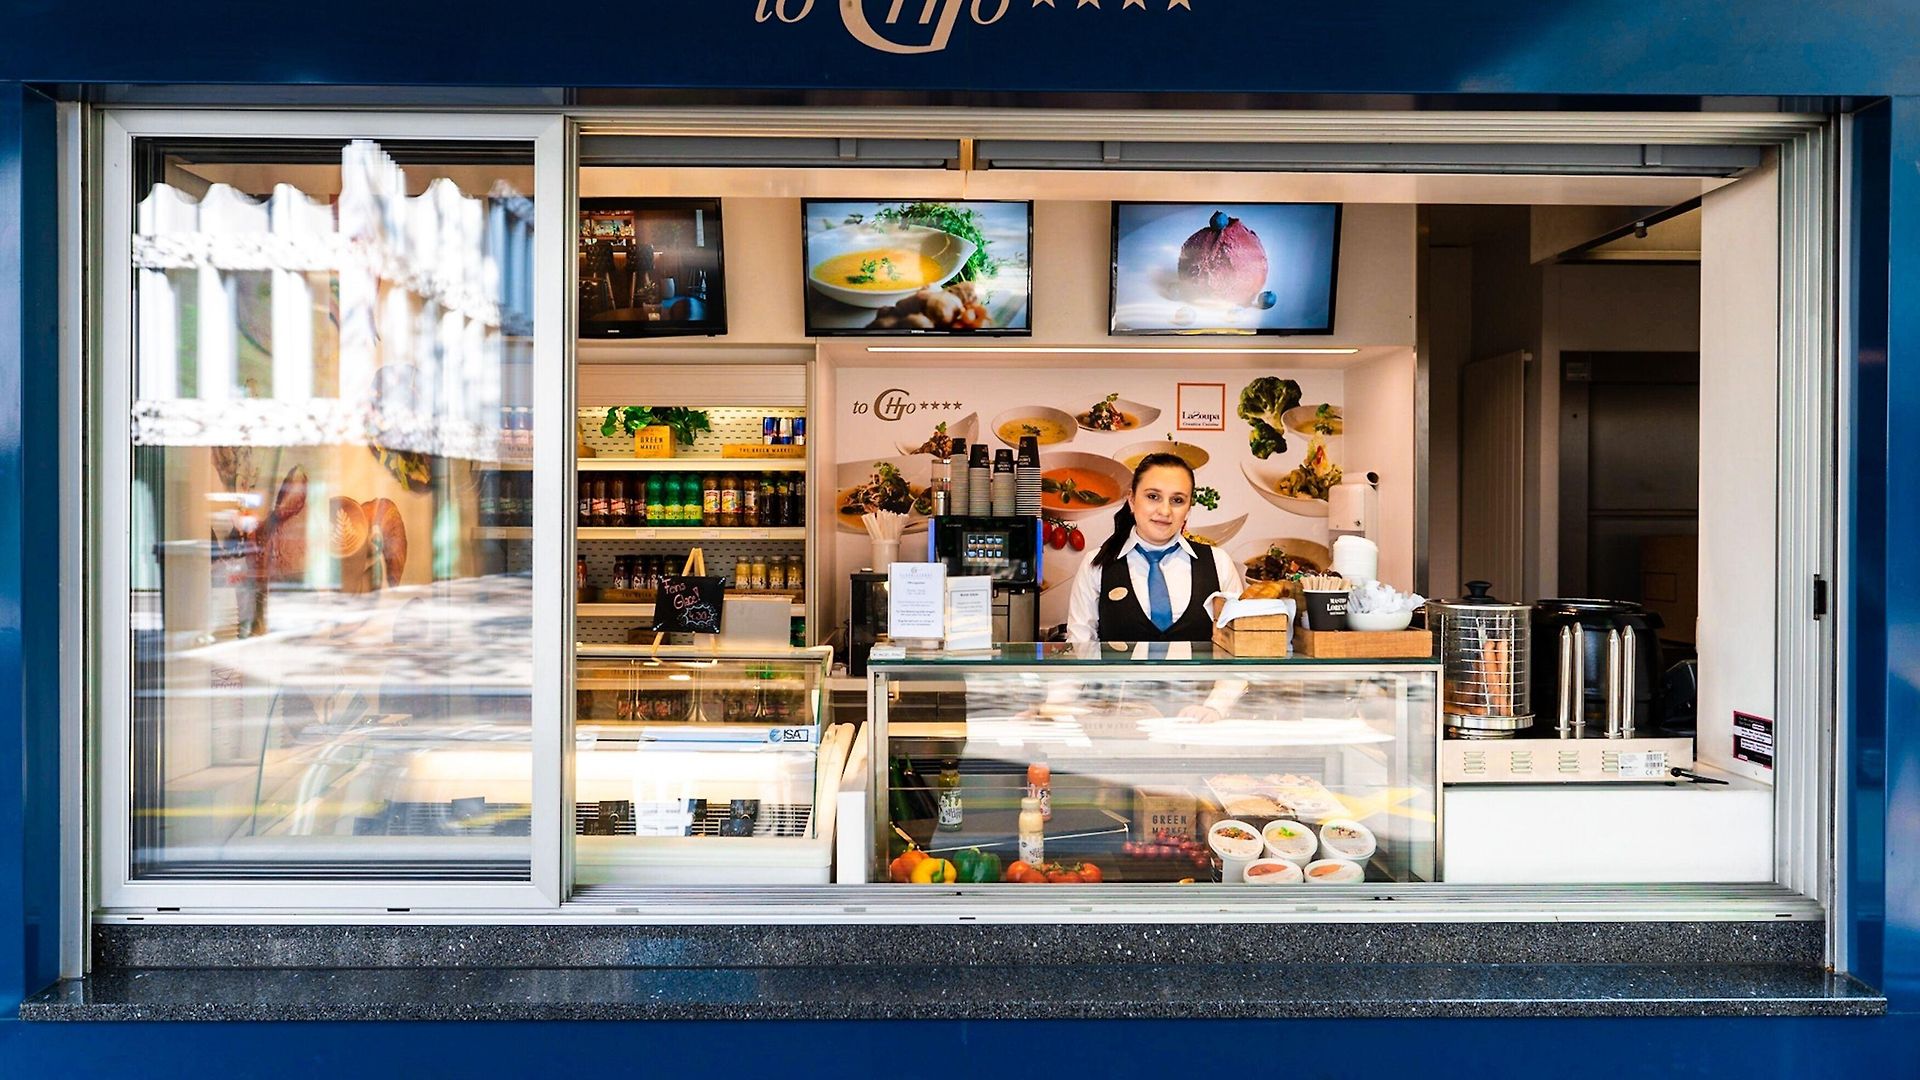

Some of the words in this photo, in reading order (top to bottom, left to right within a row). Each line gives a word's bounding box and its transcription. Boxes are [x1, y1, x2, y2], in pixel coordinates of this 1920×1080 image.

[852, 400, 868, 414] to
[783, 729, 801, 740] ISA
[1152, 814, 1187, 825] GREEN
